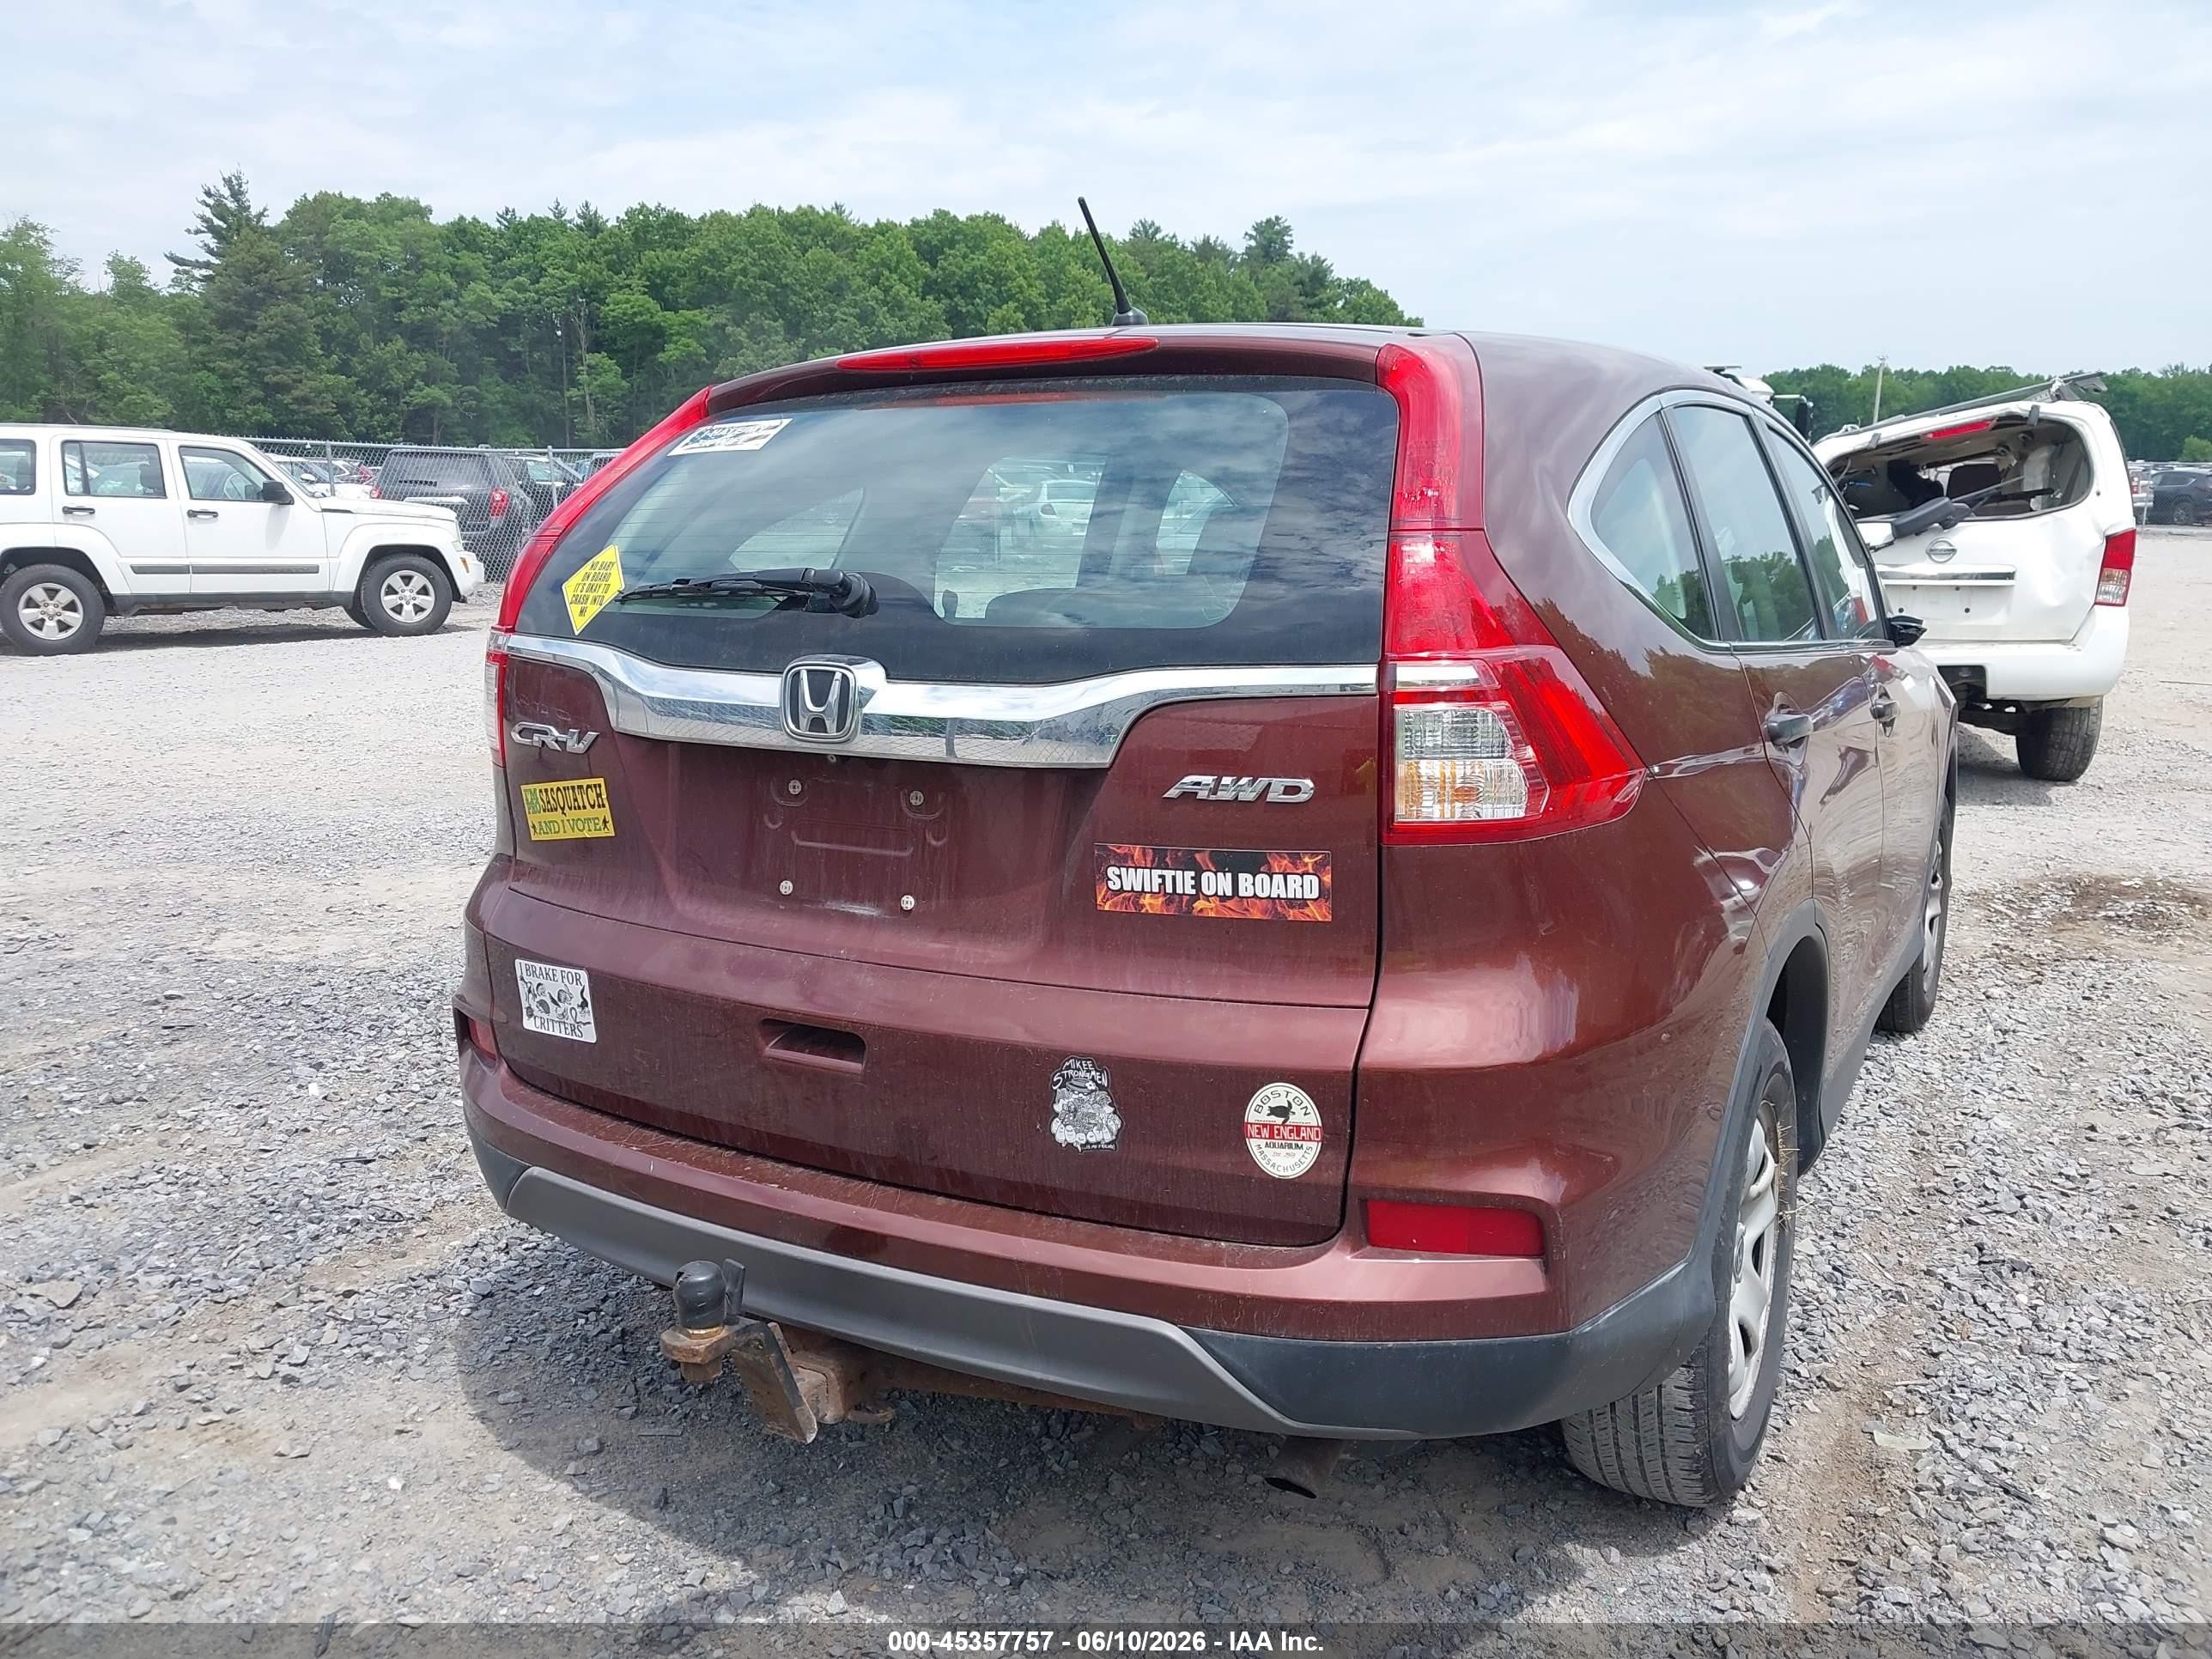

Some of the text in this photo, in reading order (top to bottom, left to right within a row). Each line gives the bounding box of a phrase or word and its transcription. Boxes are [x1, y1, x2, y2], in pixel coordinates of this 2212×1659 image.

[581, 571, 612, 582] ON BOARD
[589, 561, 617, 571] NO BABY
[574, 583, 611, 594] IT'S OKAY TO
[570, 593, 605, 606] CRASH INTO
[579, 605, 588, 617] ME
[510, 721, 600, 754] CR-V
[1162, 775, 1315, 803] AWD
[538, 783, 606, 817] SASQUATCH
[538, 817, 603, 835] AND I VOTE
[1106, 866, 1320, 900] SWIFTIE ON BOARD
[519, 962, 583, 987] I BRAKE FOR
[533, 1015, 583, 1038] CRITTERS
[1052, 1069, 1108, 1090] STRONGMEN
[1254, 1090, 1311, 1116] BOSTON
[1247, 1124, 1322, 1141] NEW ENGLAND
[1264, 1141, 1304, 1151] AQUARIUM
[1255, 1144, 1313, 1172] MASSACHUSETTS
